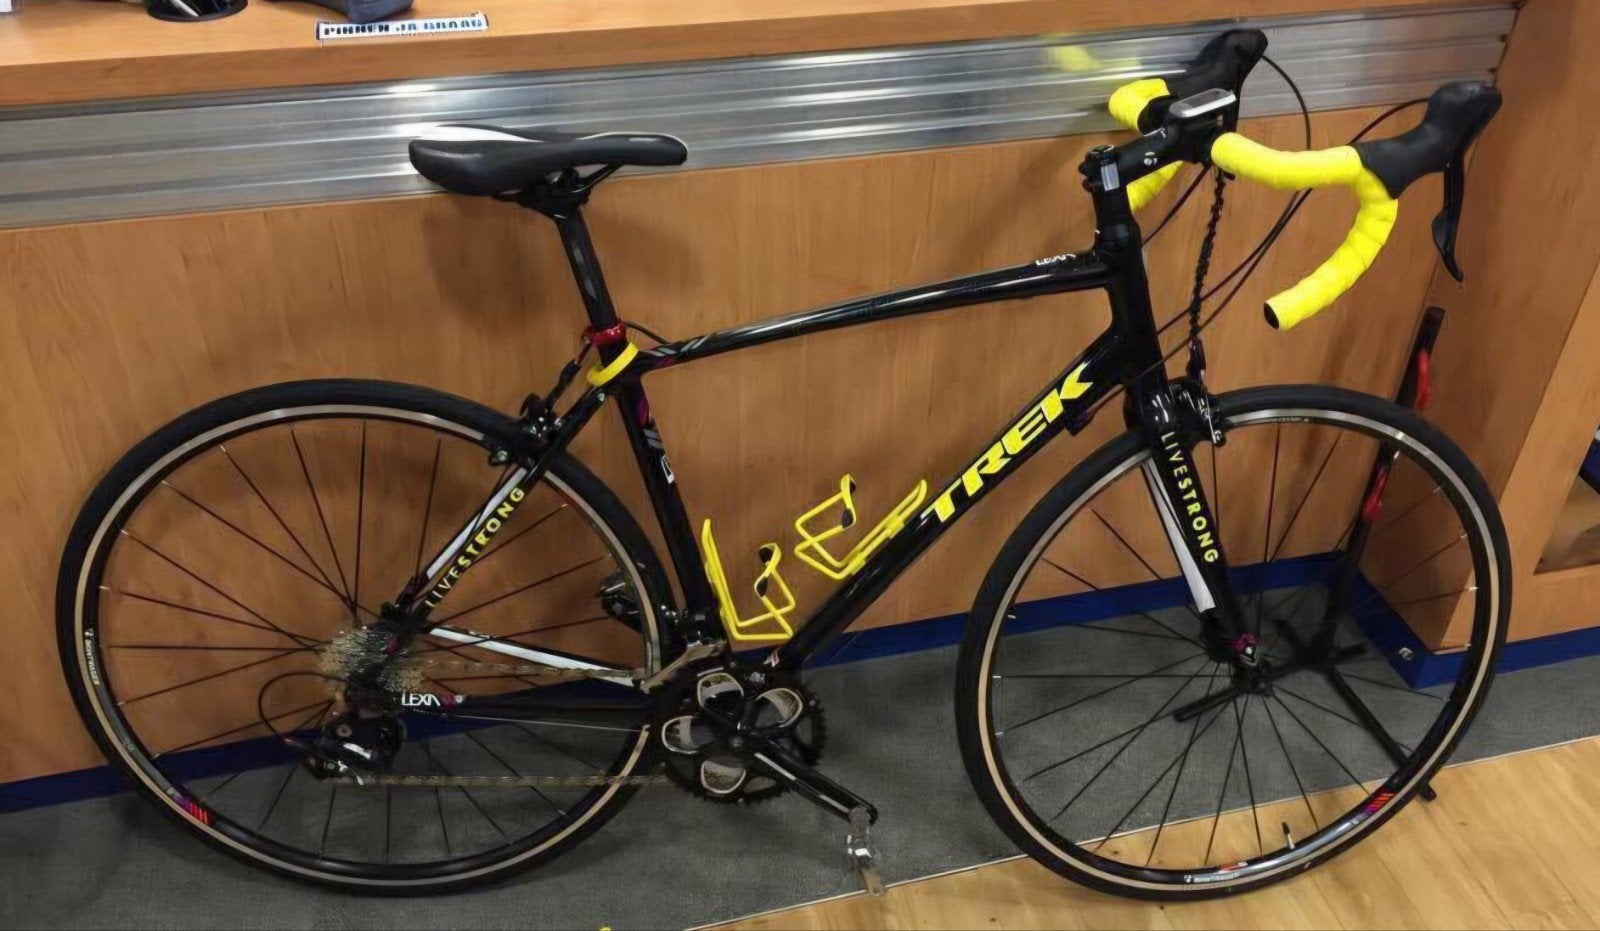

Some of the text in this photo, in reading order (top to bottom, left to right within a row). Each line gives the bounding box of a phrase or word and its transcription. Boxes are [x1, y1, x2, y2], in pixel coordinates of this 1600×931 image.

[919, 360, 1094, 523] TREK
[1161, 431, 1219, 563] LIVESTRONG
[425, 487, 525, 608] LIVESTRONG
